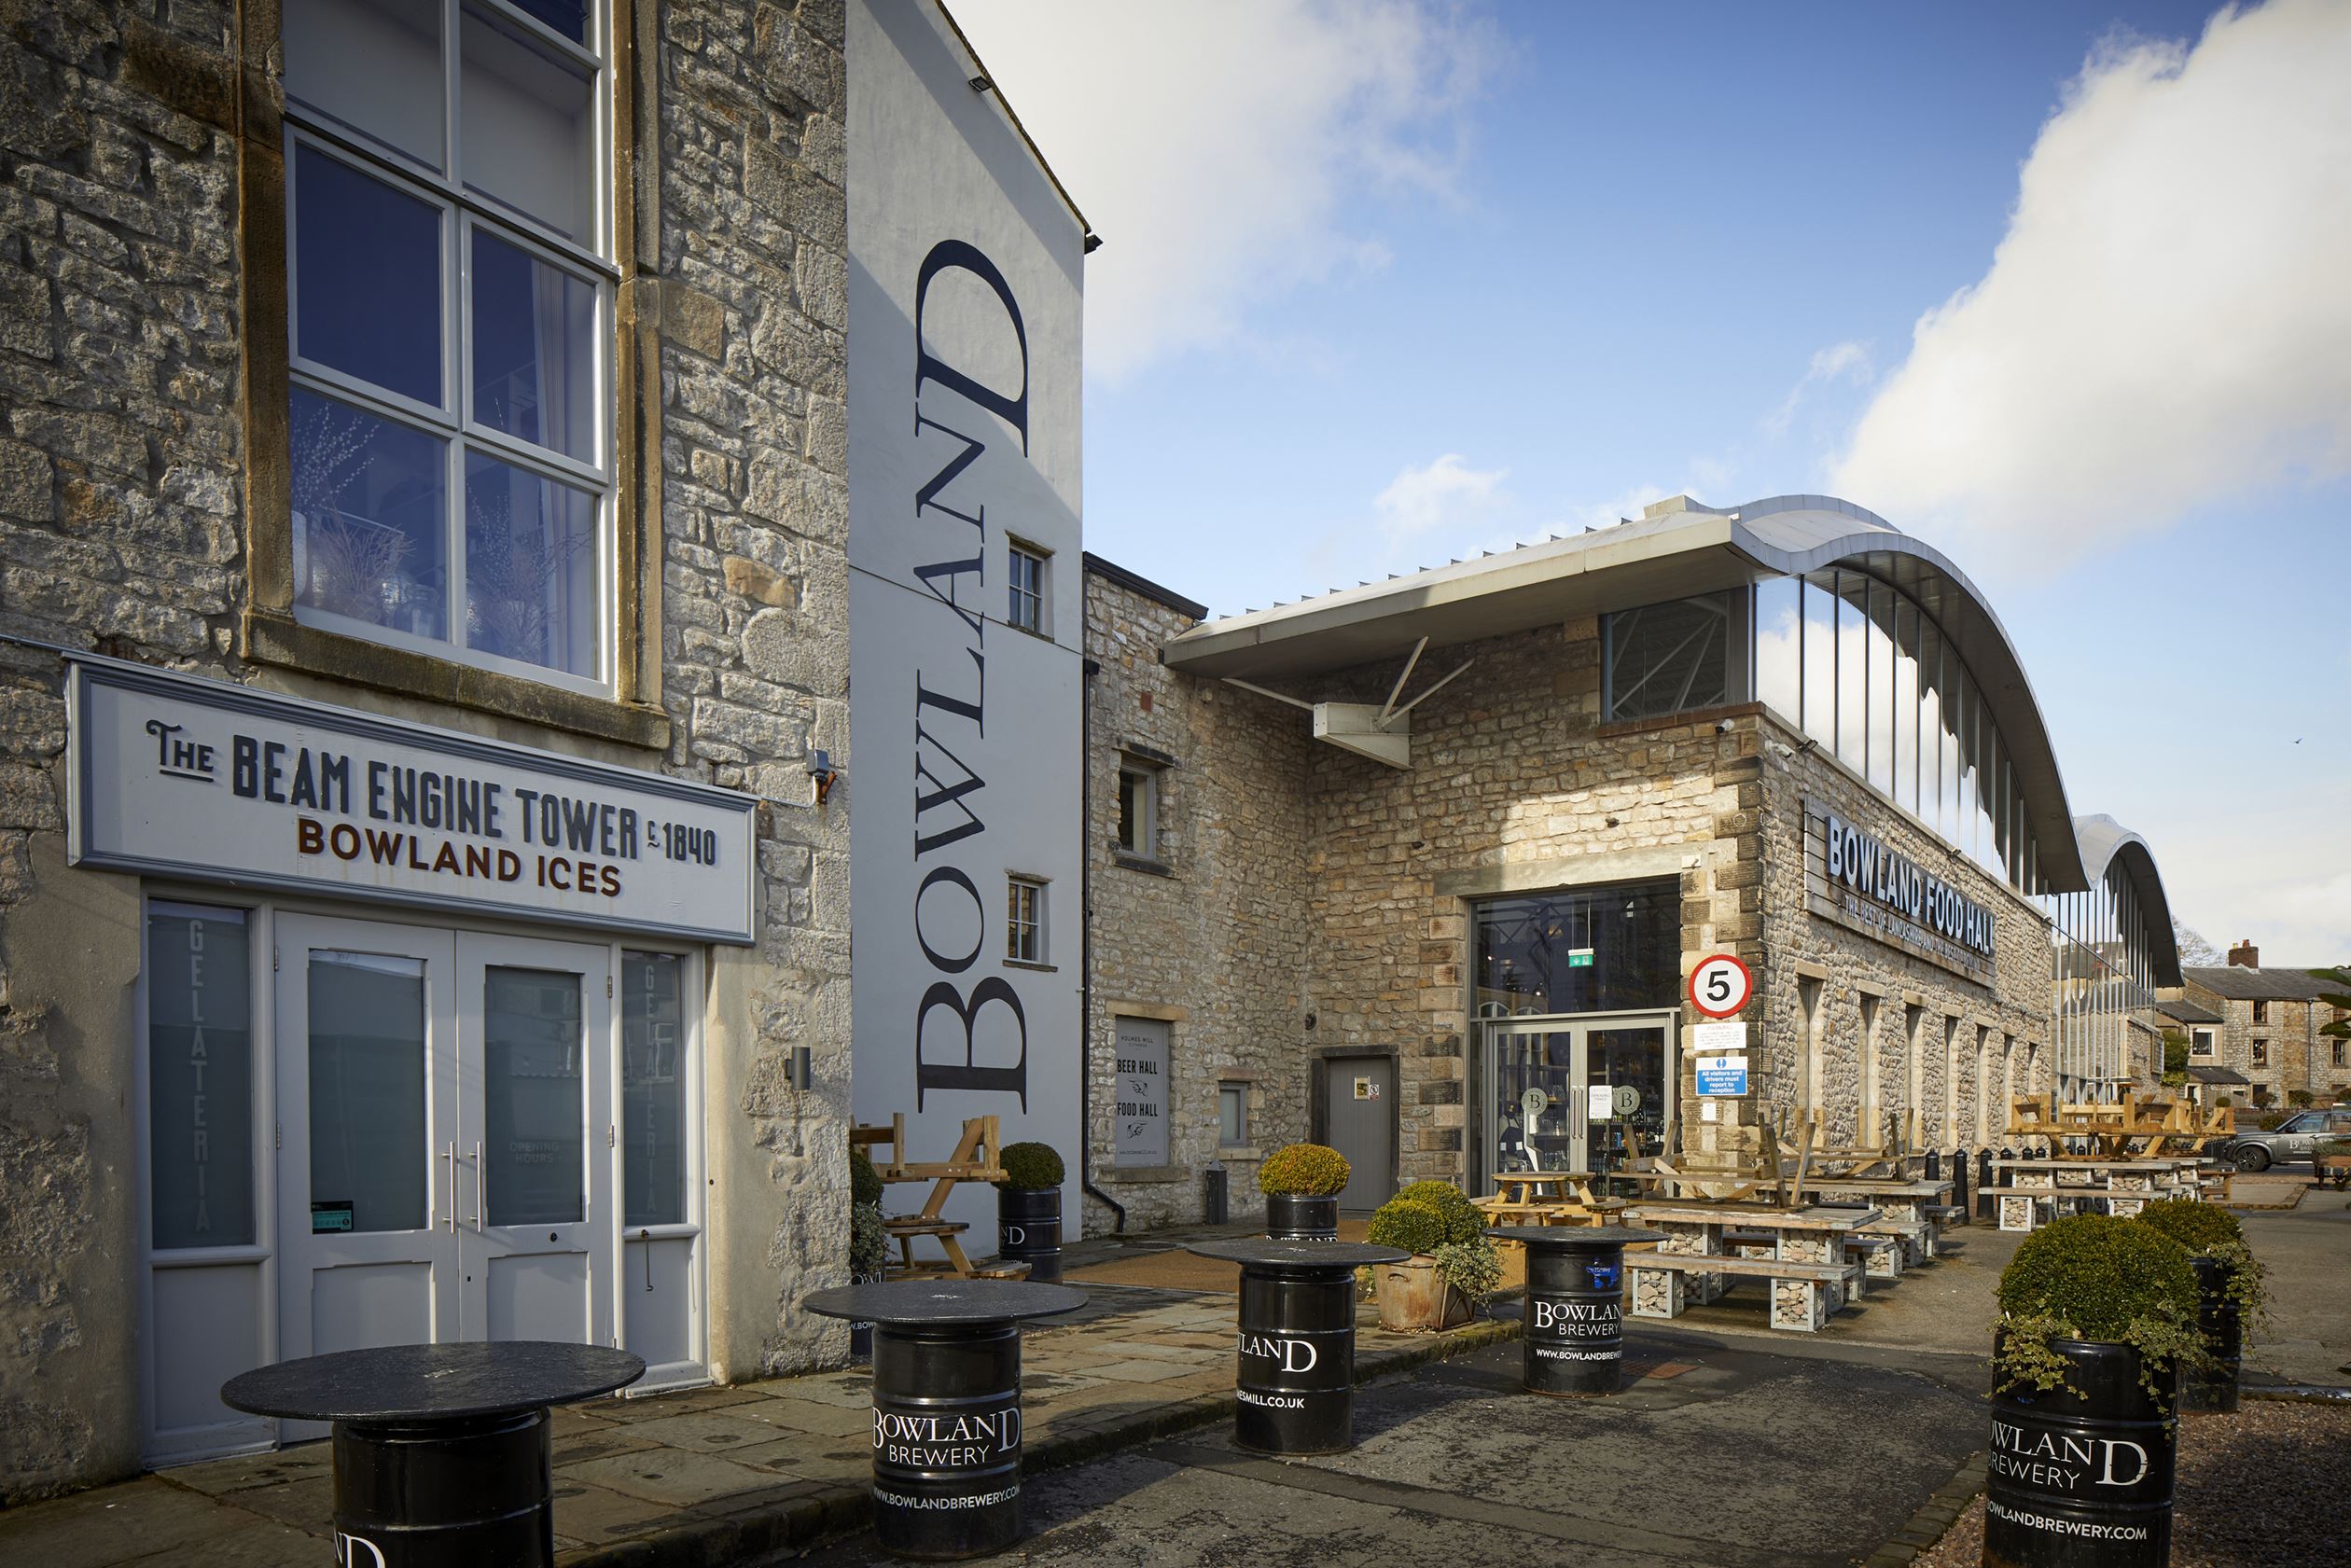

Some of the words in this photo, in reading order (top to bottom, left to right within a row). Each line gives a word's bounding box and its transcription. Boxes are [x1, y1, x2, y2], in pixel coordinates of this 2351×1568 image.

[915, 238, 1028, 1116] BOWLAND
[146, 719, 215, 773] THE
[233, 734, 349, 813] BEAM
[369, 760, 502, 838] ENGINE
[516, 788, 637, 859] TOWER
[299, 818, 521, 881] BOWLAND
[538, 855, 620, 896] ICES
[1826, 816, 1921, 918] BOWLAND
[1927, 876, 1963, 939] FOOD
[1706, 970, 1730, 1001] 5
[189, 920, 211, 1232] GELATERIA
[1118, 1059, 1136, 1074] BEER
[1139, 1060, 1158, 1075] HALL
[1118, 1102, 1136, 1117] FOOD
[1139, 1103, 1158, 1117] HALL
[1530, 1094, 1539, 1108] B
[1621, 1092, 1632, 1107] B
[508, 1142, 560, 1152] OPENING
[515, 1153, 554, 1163] HOURS
[1559, 1323, 1619, 1336] BREWERY
[872, 1407, 1021, 1452] BOWLAND
[889, 1444, 990, 1465] BREWERY
